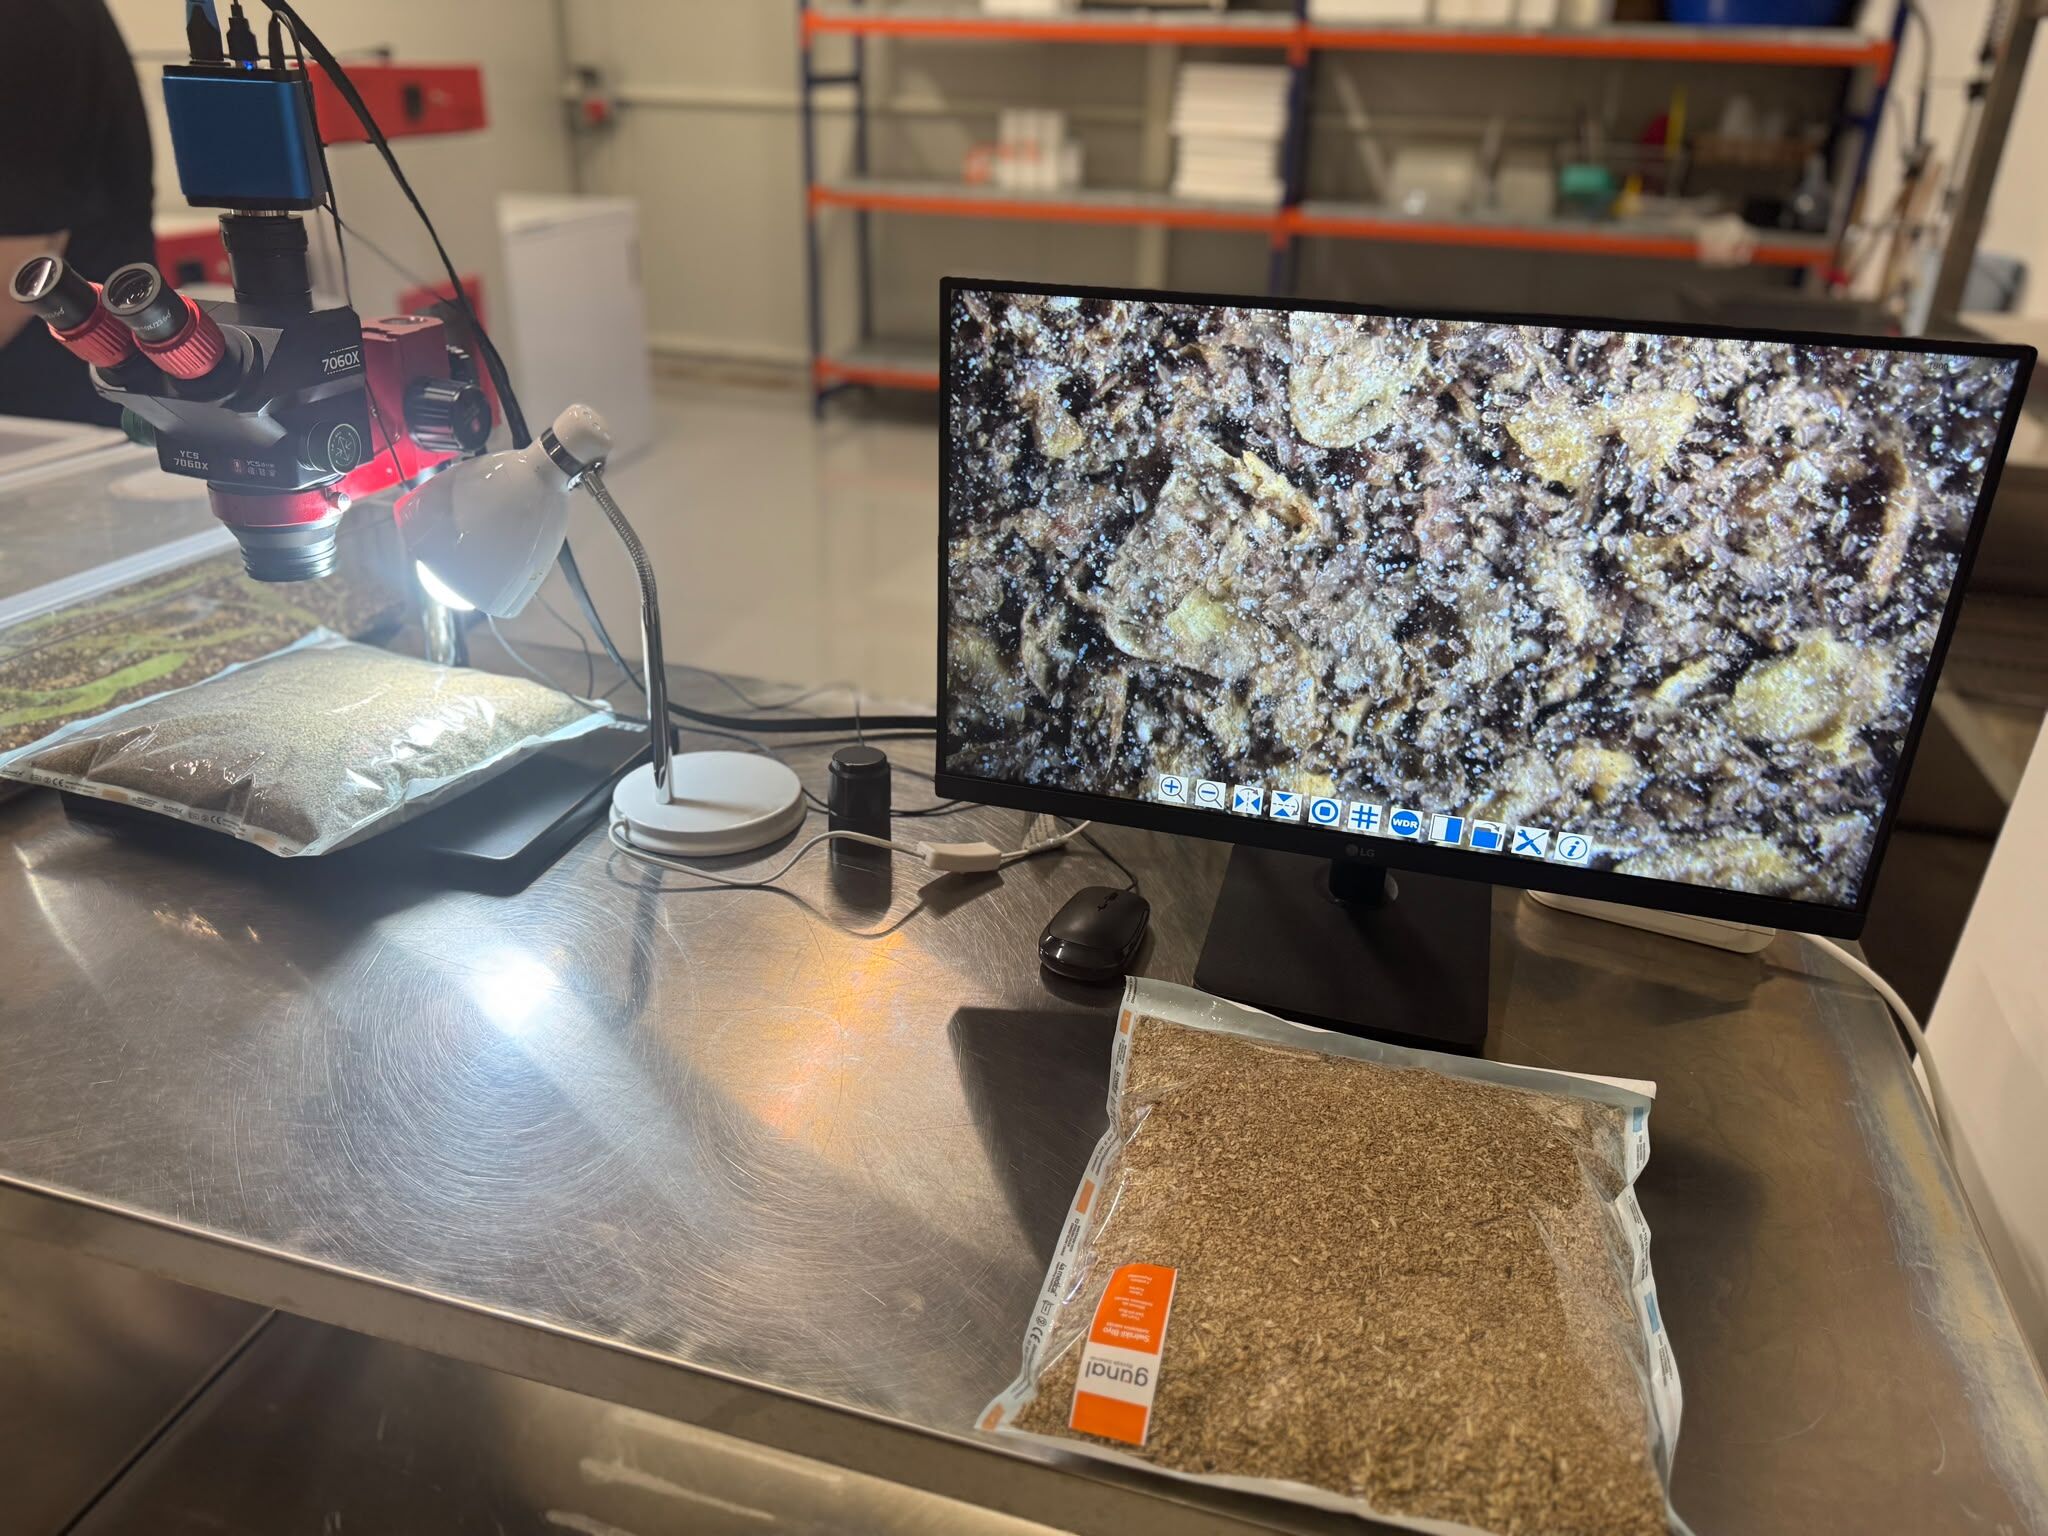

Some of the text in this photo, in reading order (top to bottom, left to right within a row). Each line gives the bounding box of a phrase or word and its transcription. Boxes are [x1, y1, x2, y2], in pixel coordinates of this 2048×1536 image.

[322, 350, 360, 372] 7060X
[180, 450, 199, 460] YCS
[173, 457, 208, 471] 7060X
[1392, 817, 1418, 829] WDR
[1360, 847, 1375, 857] LG
